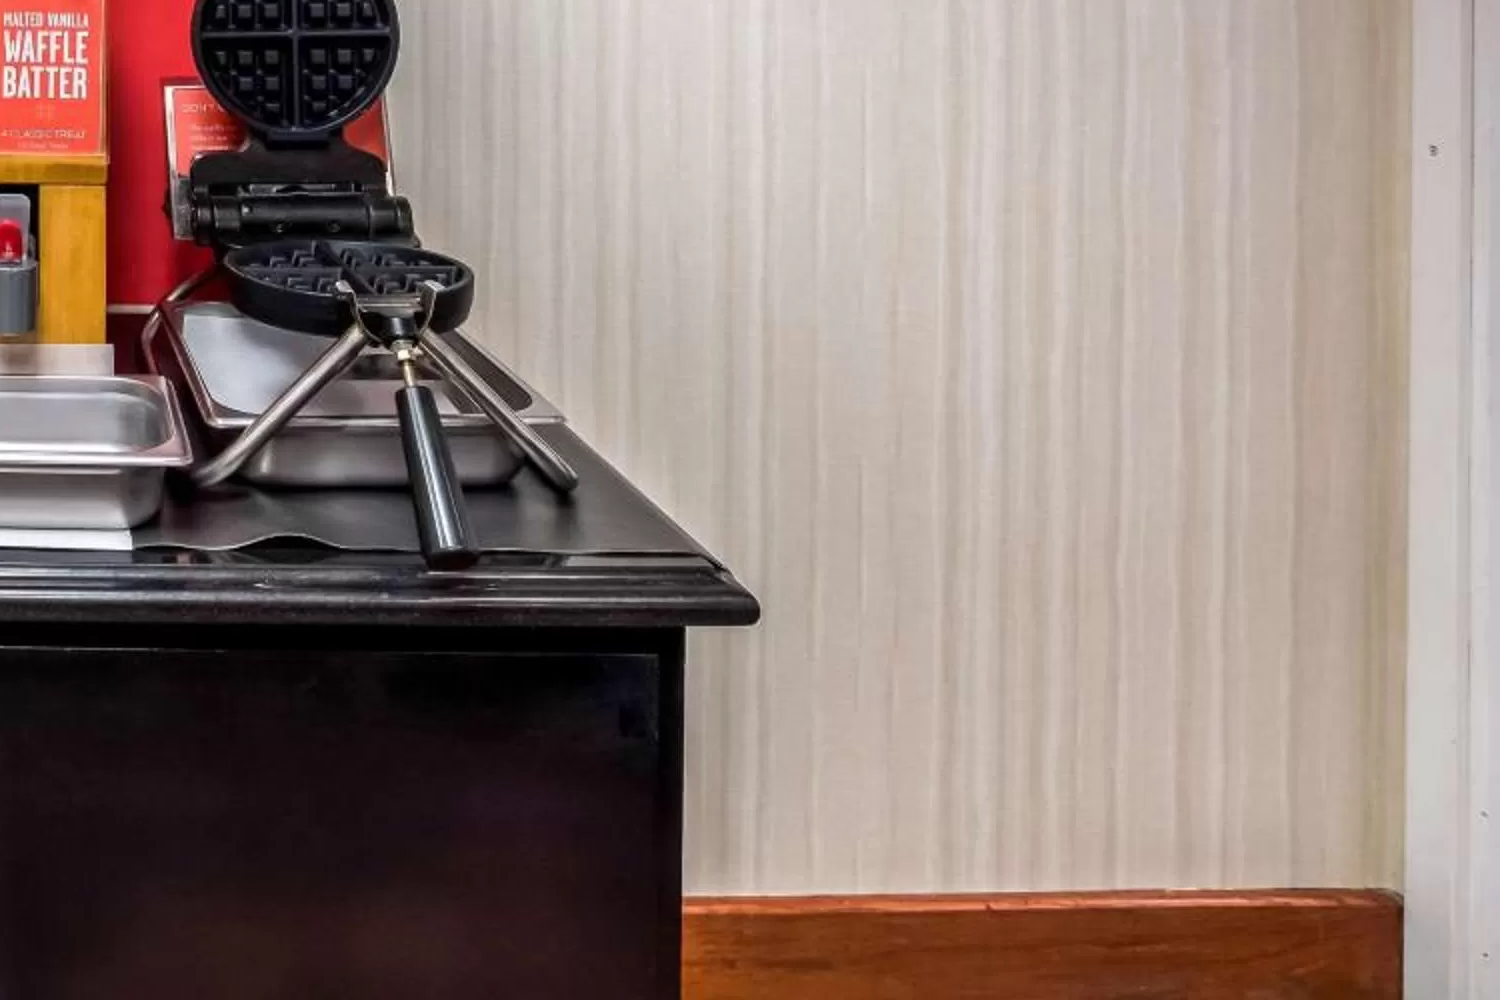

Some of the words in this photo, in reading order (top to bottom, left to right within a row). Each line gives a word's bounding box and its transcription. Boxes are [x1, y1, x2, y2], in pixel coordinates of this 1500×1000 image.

[3, 11, 43, 27] MALTED
[47, 12, 89, 28] VANILLA
[3, 29, 89, 65] WAFFLE
[2, 65, 88, 99] BATTER
